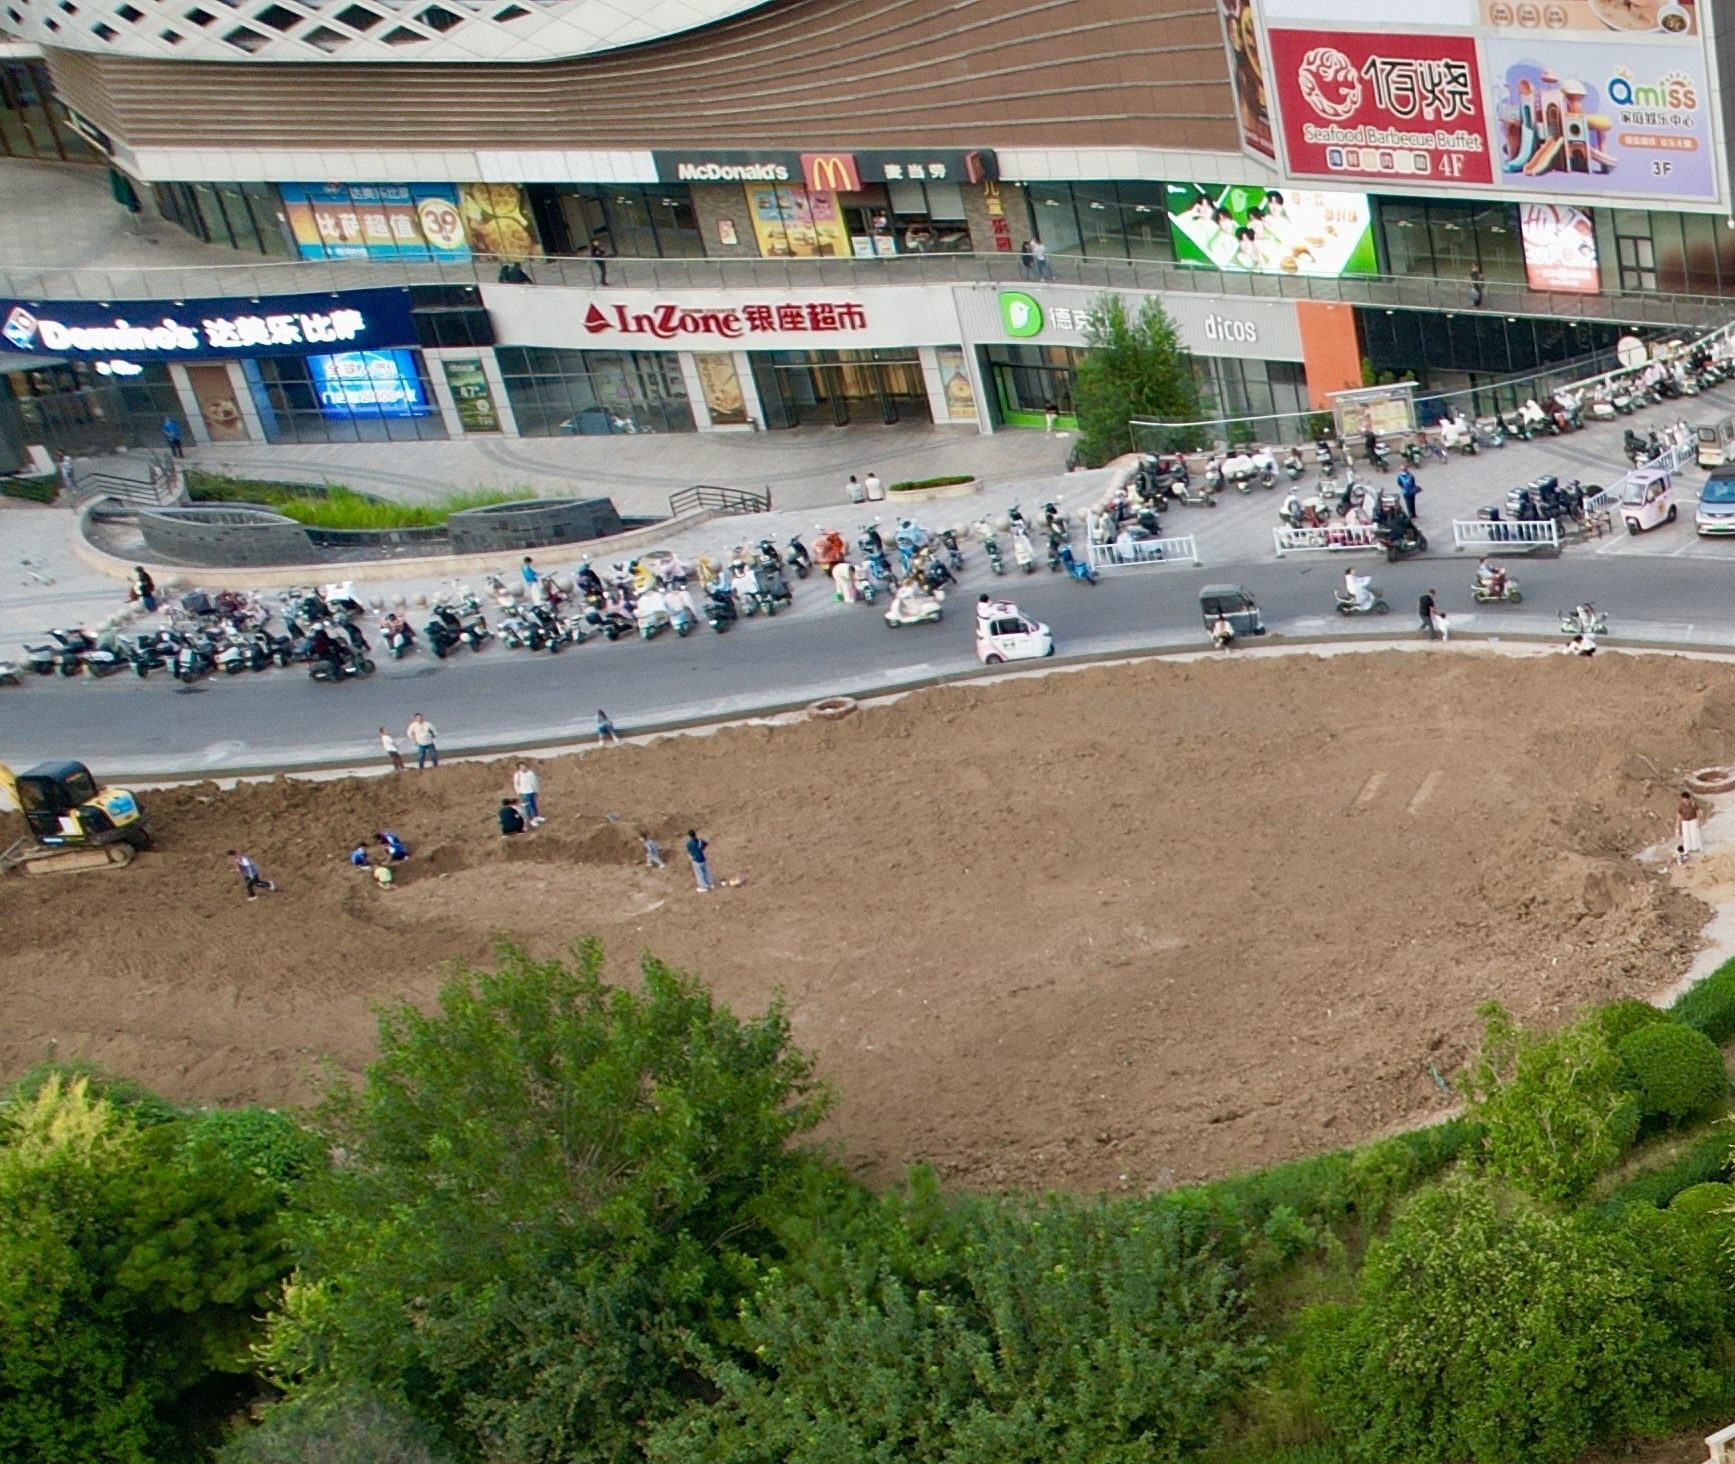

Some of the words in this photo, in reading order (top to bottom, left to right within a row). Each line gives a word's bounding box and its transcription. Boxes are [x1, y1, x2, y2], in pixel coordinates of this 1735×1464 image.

[1303, 123, 1364, 145] Seafood
[1367, 127, 1434, 147] Barbecue
[1437, 130, 1482, 151] Buffet
[678, 163, 789, 181] McDonald's
[884, 163, 947, 180] 麦当劳
[1438, 153, 1465, 177] 4F
[1652, 161, 1672, 175] 3F
[202, 308, 367, 347] 达美乐比萨
[744, 303, 868, 332] 银座超市
[1204, 313, 1258, 343] dicos
[38, 318, 199, 350] Domino's
